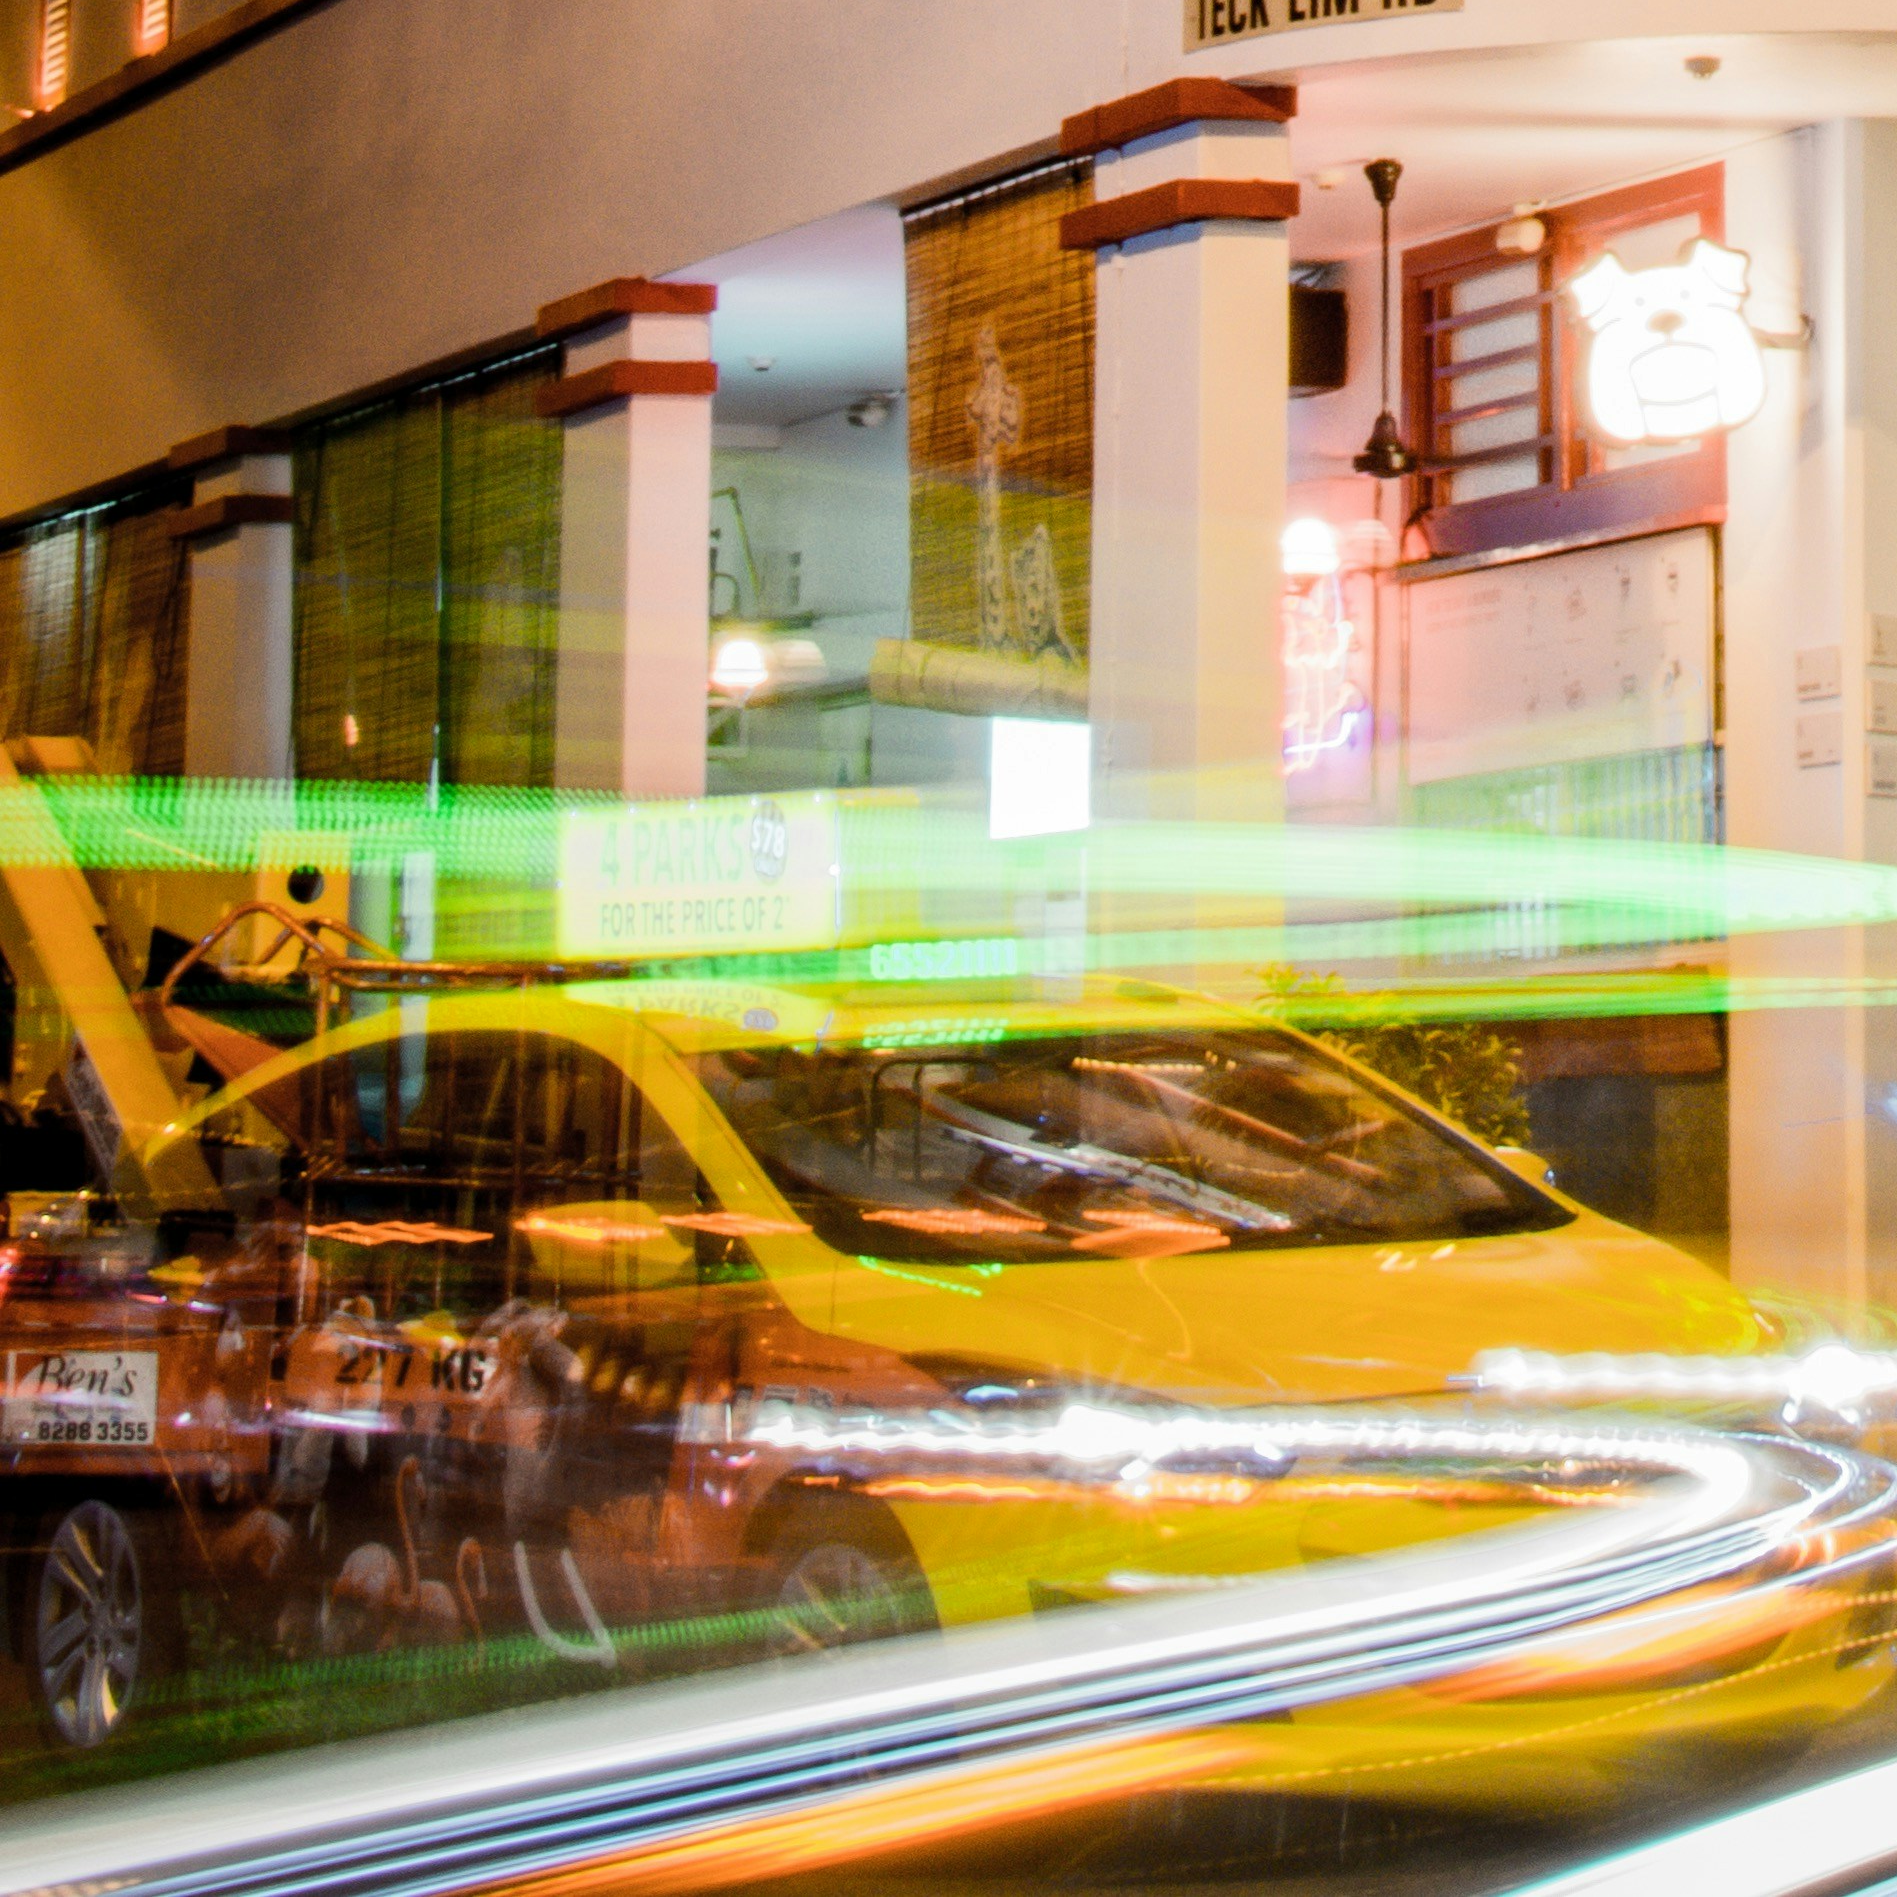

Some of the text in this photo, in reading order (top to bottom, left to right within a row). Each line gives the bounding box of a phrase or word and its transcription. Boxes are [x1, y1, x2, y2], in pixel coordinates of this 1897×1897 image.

[601, 813, 746, 886] 4 PARKS
[601, 901, 636, 938] FOR
[641, 900, 676, 936] THE
[682, 896, 736, 934] PRICE
[742, 895, 767, 932] OF
[38, 1421, 149, 1442] 8288 3355
